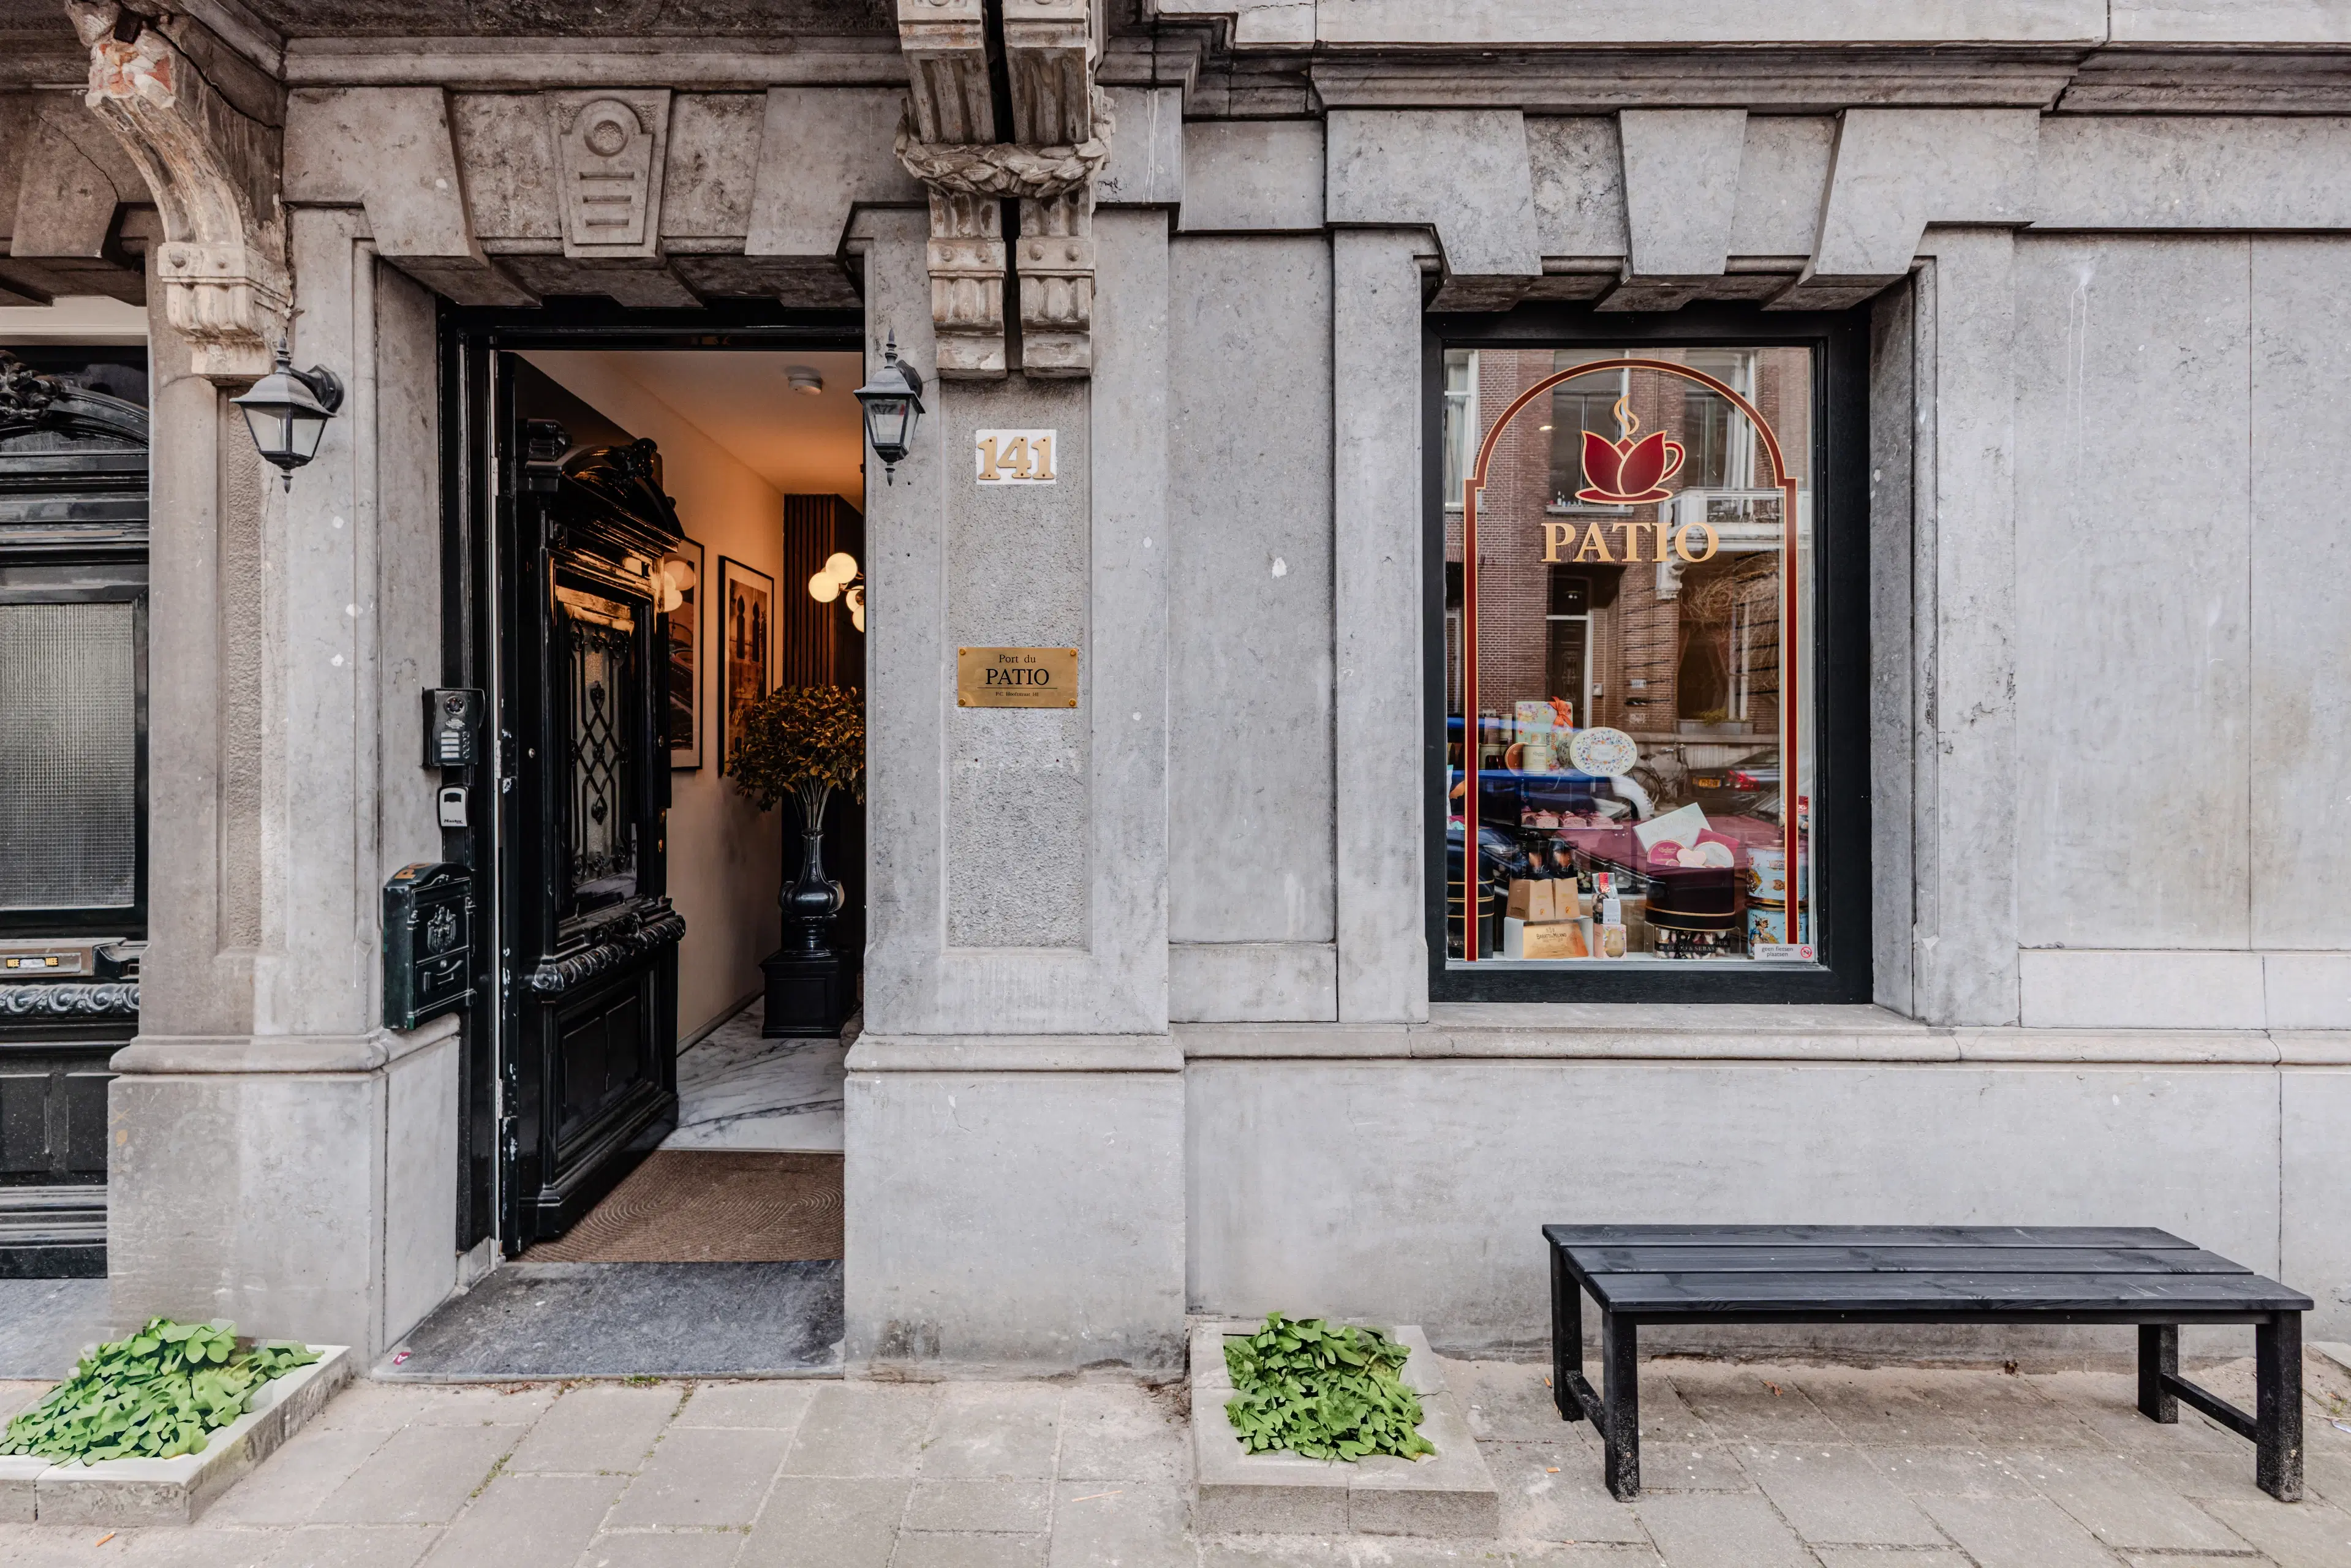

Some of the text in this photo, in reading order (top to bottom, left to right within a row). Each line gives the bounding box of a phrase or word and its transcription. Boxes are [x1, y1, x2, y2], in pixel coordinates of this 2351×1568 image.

[978, 435, 1055, 480] 141
[1541, 522, 1719, 563] PATIO
[999, 654, 1036, 663] Port du
[986, 669, 1049, 685] PATIO
[7, 957, 58, 967] NEE NEE
